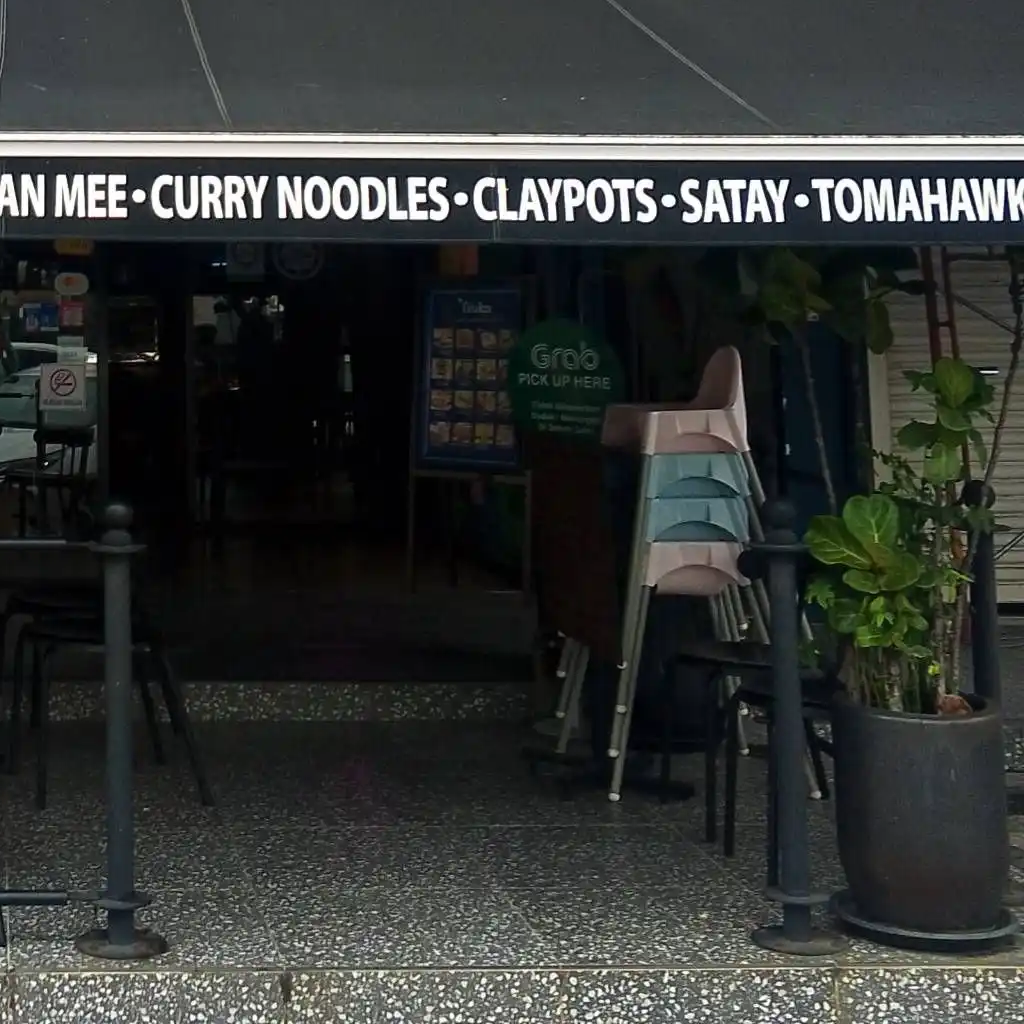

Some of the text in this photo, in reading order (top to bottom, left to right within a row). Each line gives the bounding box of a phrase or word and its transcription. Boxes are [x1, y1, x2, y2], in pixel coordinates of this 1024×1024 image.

[54, 174, 128, 219] MEE
[150, 174, 269, 219] CURRY
[276, 175, 450, 222] NOODLES
[473, 176, 658, 224] CLAYPOTS
[680, 178, 790, 224] SATAY
[811, 178, 1024, 223] TOMAHAWK
[530, 340, 601, 371] Grab
[518, 372, 612, 390] PICK UP HERE
